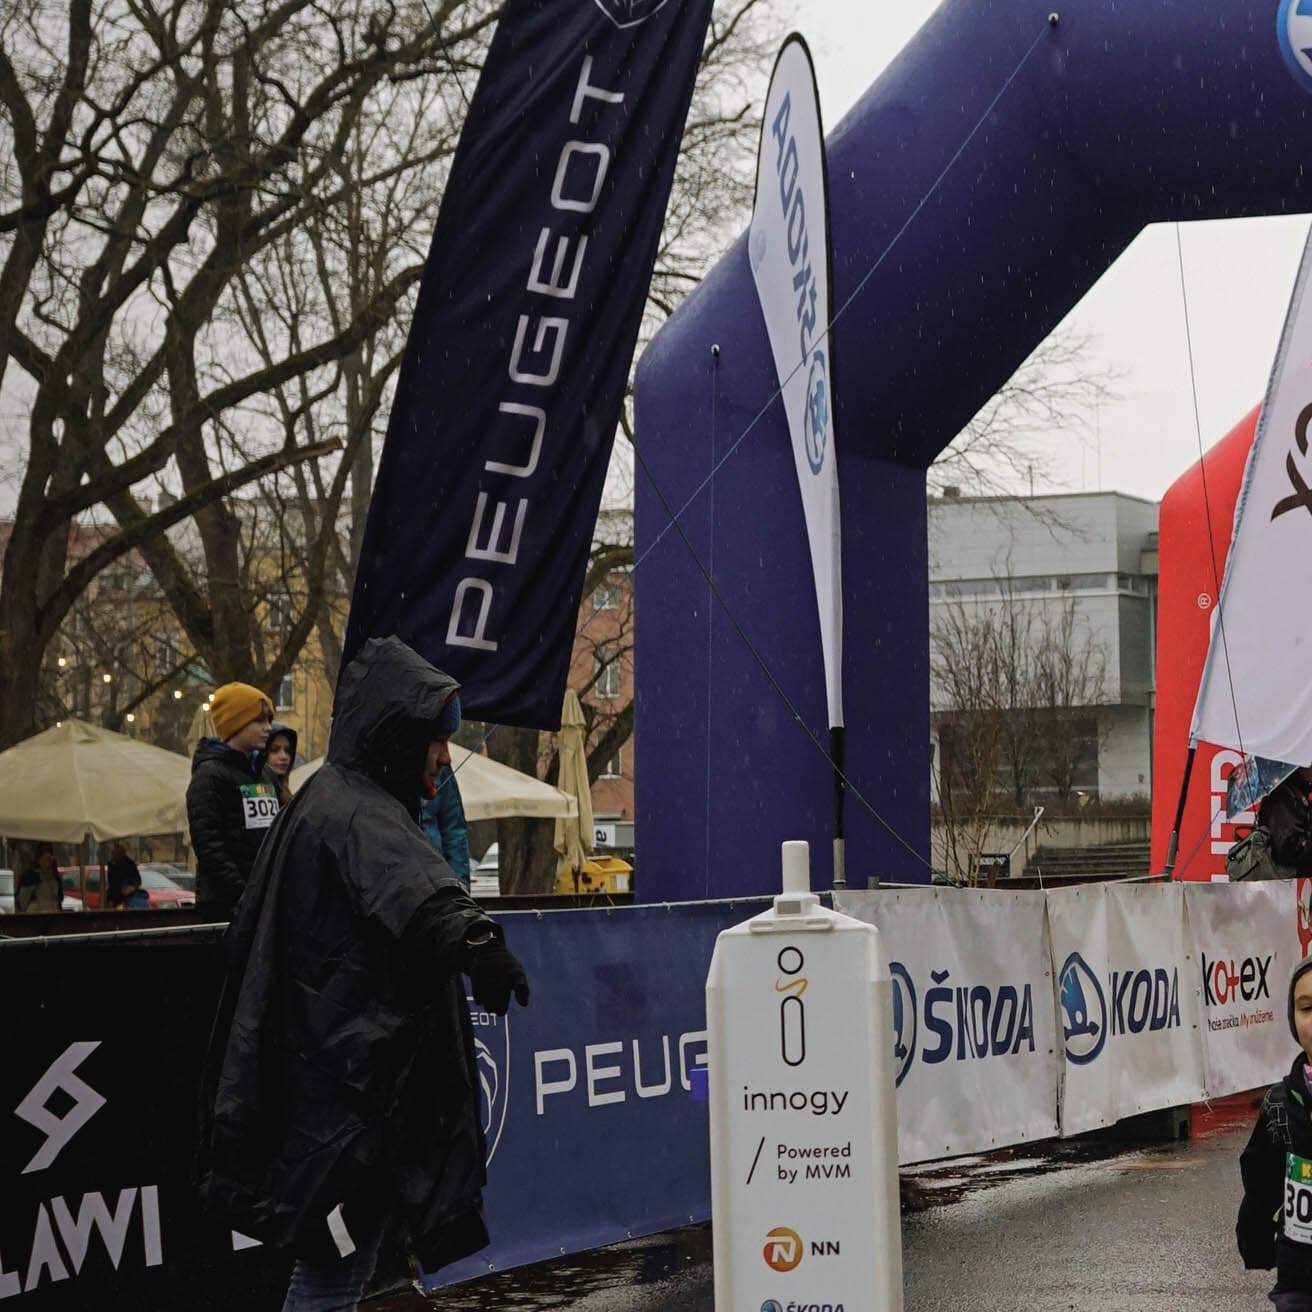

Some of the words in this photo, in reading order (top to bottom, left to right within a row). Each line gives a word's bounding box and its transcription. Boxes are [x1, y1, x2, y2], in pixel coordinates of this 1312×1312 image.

[445, 54, 625, 651] PEUGEOT
[922, 969, 1035, 1064] ŠKODA
[1109, 967, 1181, 1036] KODA
[534, 1030, 708, 1116] PEUG
[743, 1085, 849, 1116] innogy
[777, 1141, 851, 1159] Powered
[777, 1164, 798, 1184] by
[805, 1163, 851, 1179] MVM
[811, 1240, 840, 1256] NN
